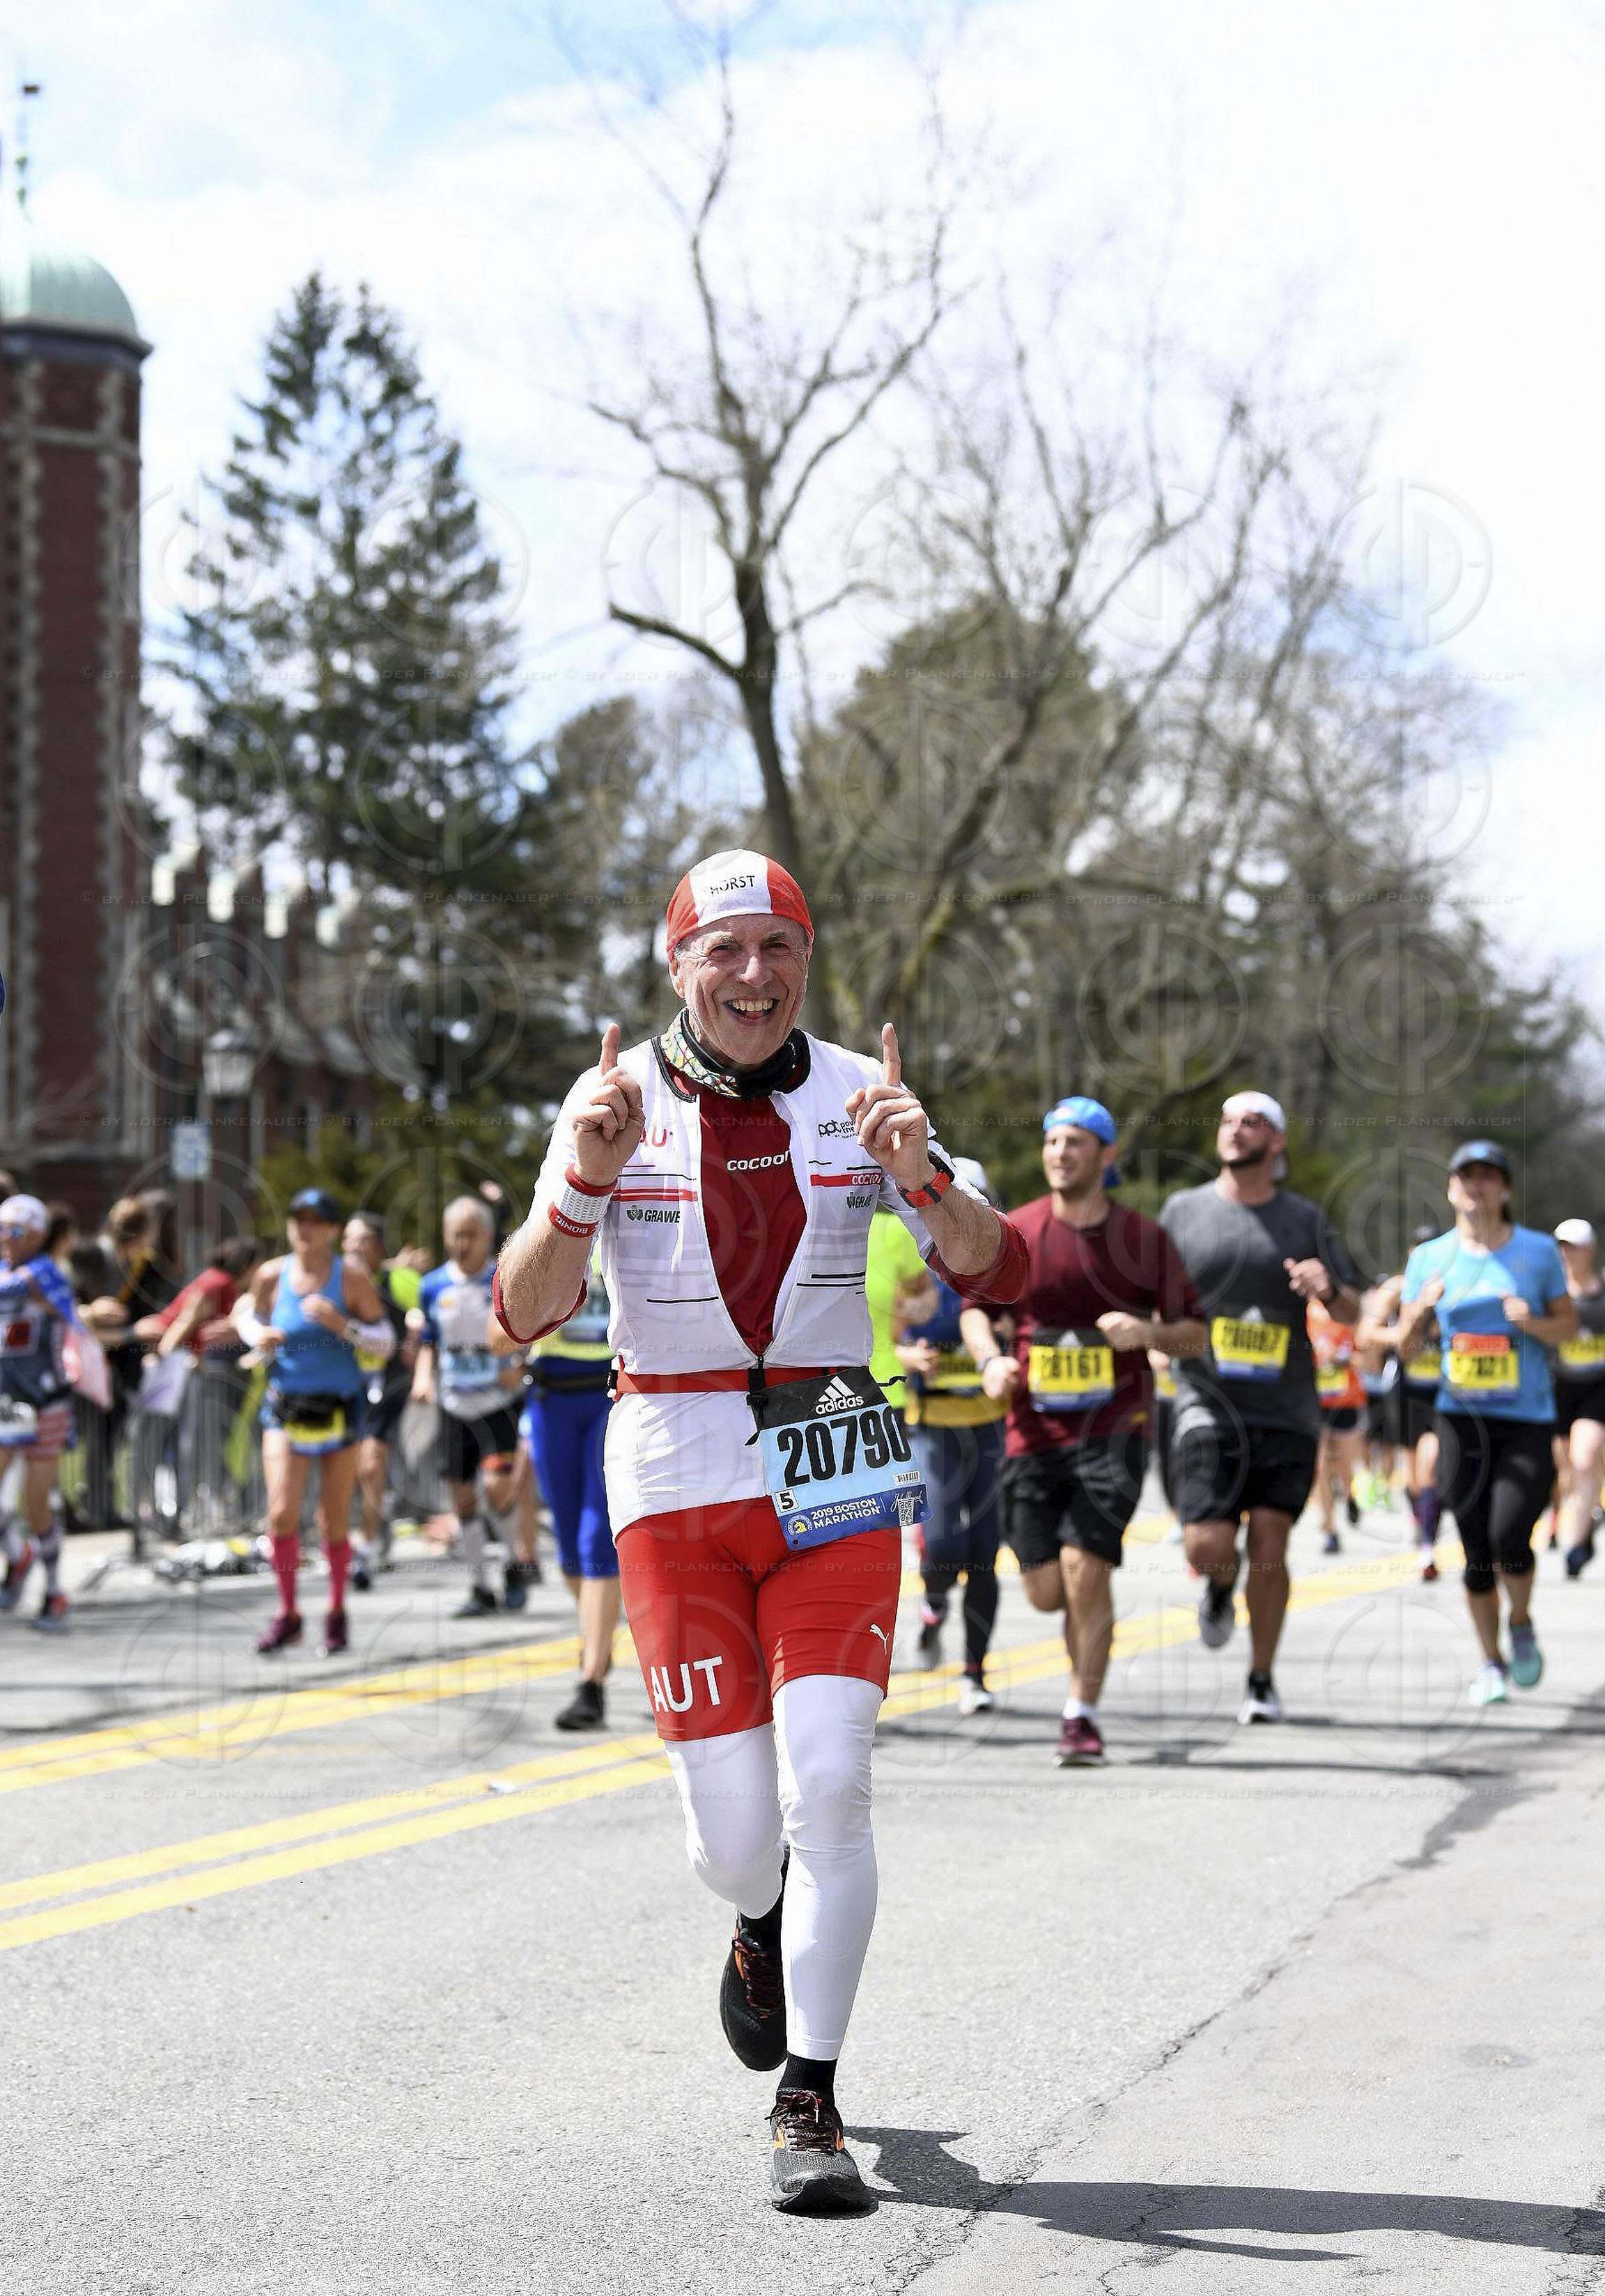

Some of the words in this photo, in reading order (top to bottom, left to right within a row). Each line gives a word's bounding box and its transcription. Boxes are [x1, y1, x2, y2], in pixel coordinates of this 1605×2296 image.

[644, 1209, 681, 1223] GRAWE
[815, 1395, 864, 1415] adidas
[777, 1405, 912, 1488] 20790
[780, 1491, 794, 1510] 5
[811, 1507, 834, 1520] 2019
[835, 1498, 877, 1515] BOSTON
[814, 1506, 880, 1528] MARATHON
[650, 1656, 723, 1713] AUT
